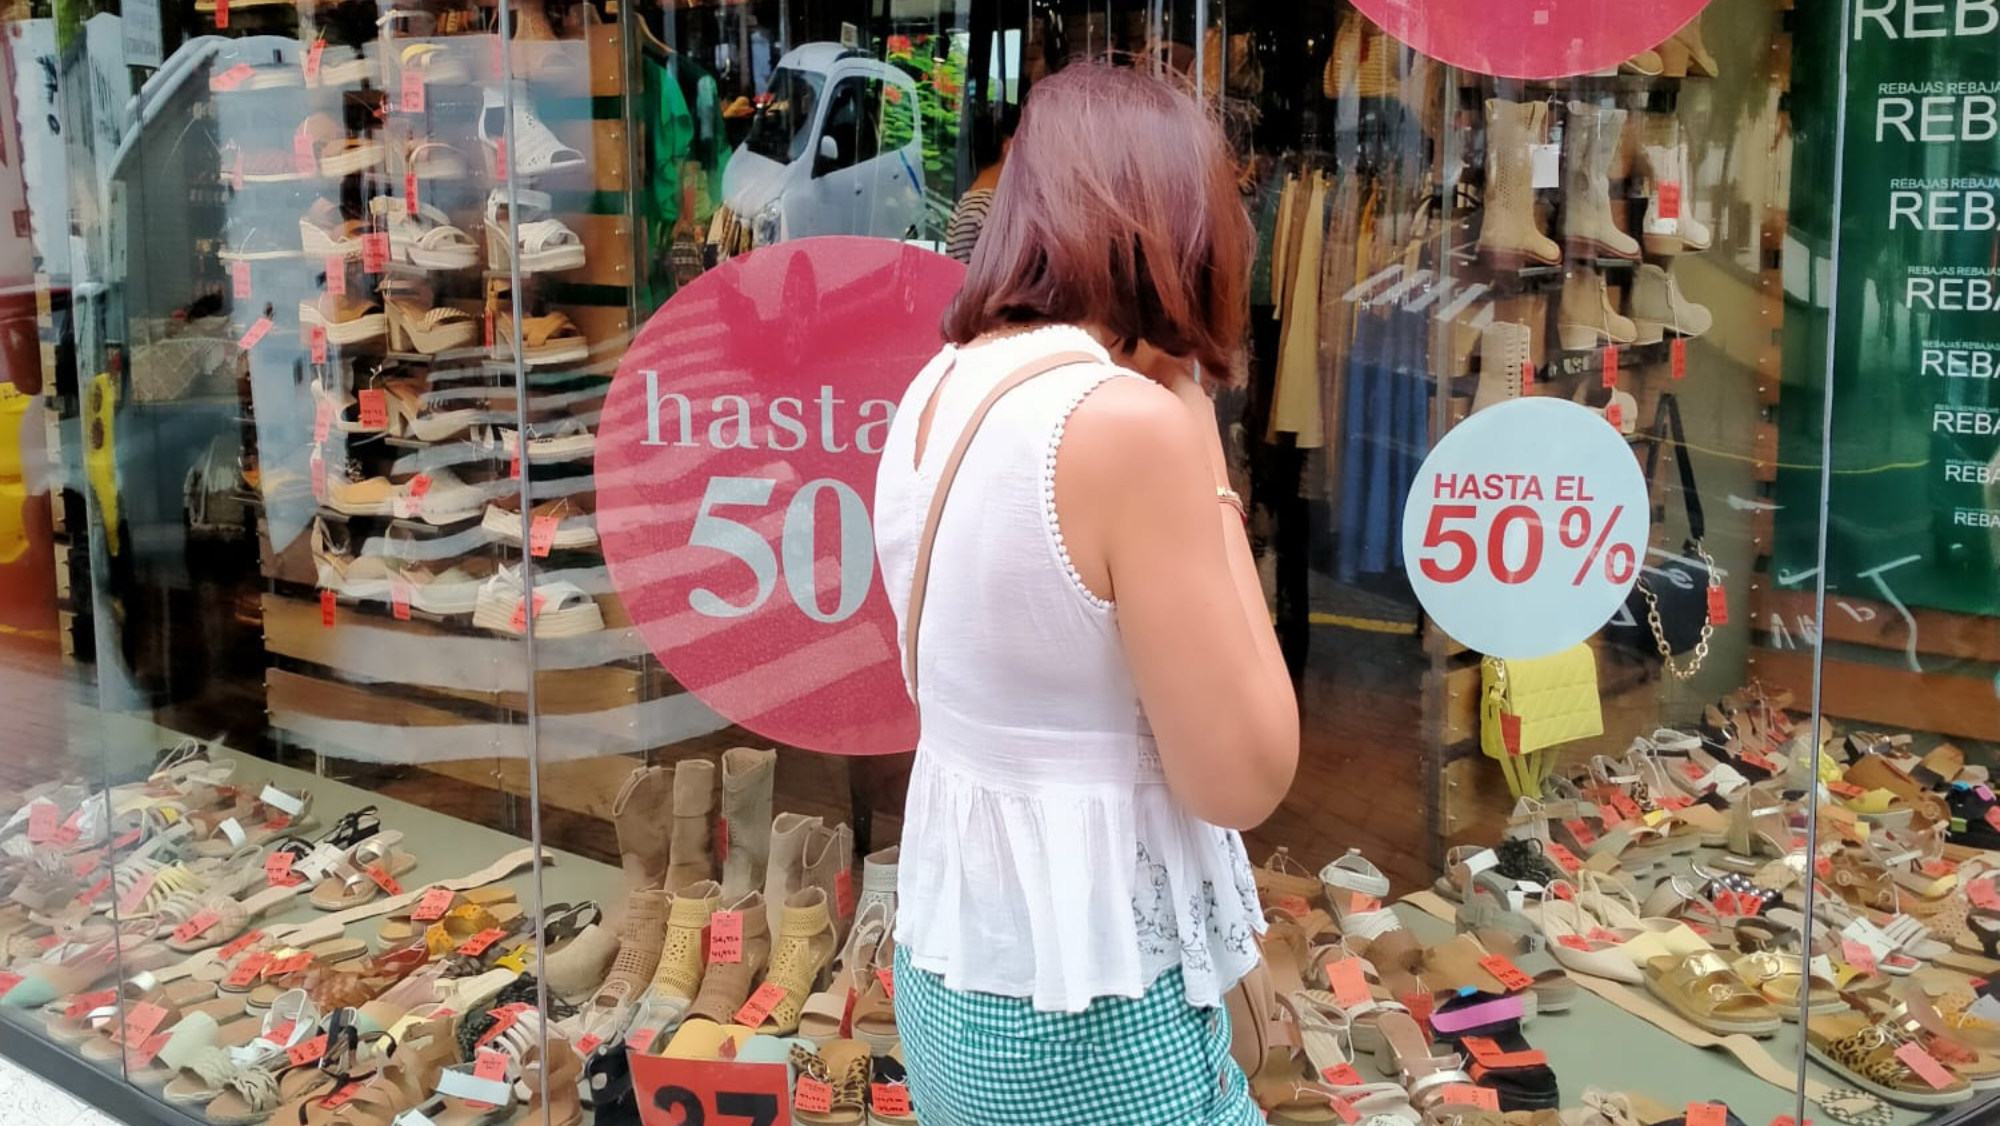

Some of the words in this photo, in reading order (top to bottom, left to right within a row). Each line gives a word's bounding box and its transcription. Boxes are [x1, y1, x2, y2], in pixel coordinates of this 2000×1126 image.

[1878, 81, 1944, 95] REBAJAS
[1875, 95, 1998, 143] REB
[1889, 178, 1949, 190] REBAJAS
[1888, 190, 2000, 231] REB
[1907, 265, 1955, 276] REBAJAS
[1906, 277, 2000, 311] REB
[1920, 349, 2000, 379] REB
[637, 369, 897, 454] hasta
[1433, 473, 1544, 500] HASTA
[1555, 475, 1594, 501] EL
[688, 475, 876, 624] 50
[1418, 504, 1636, 586] 50%
